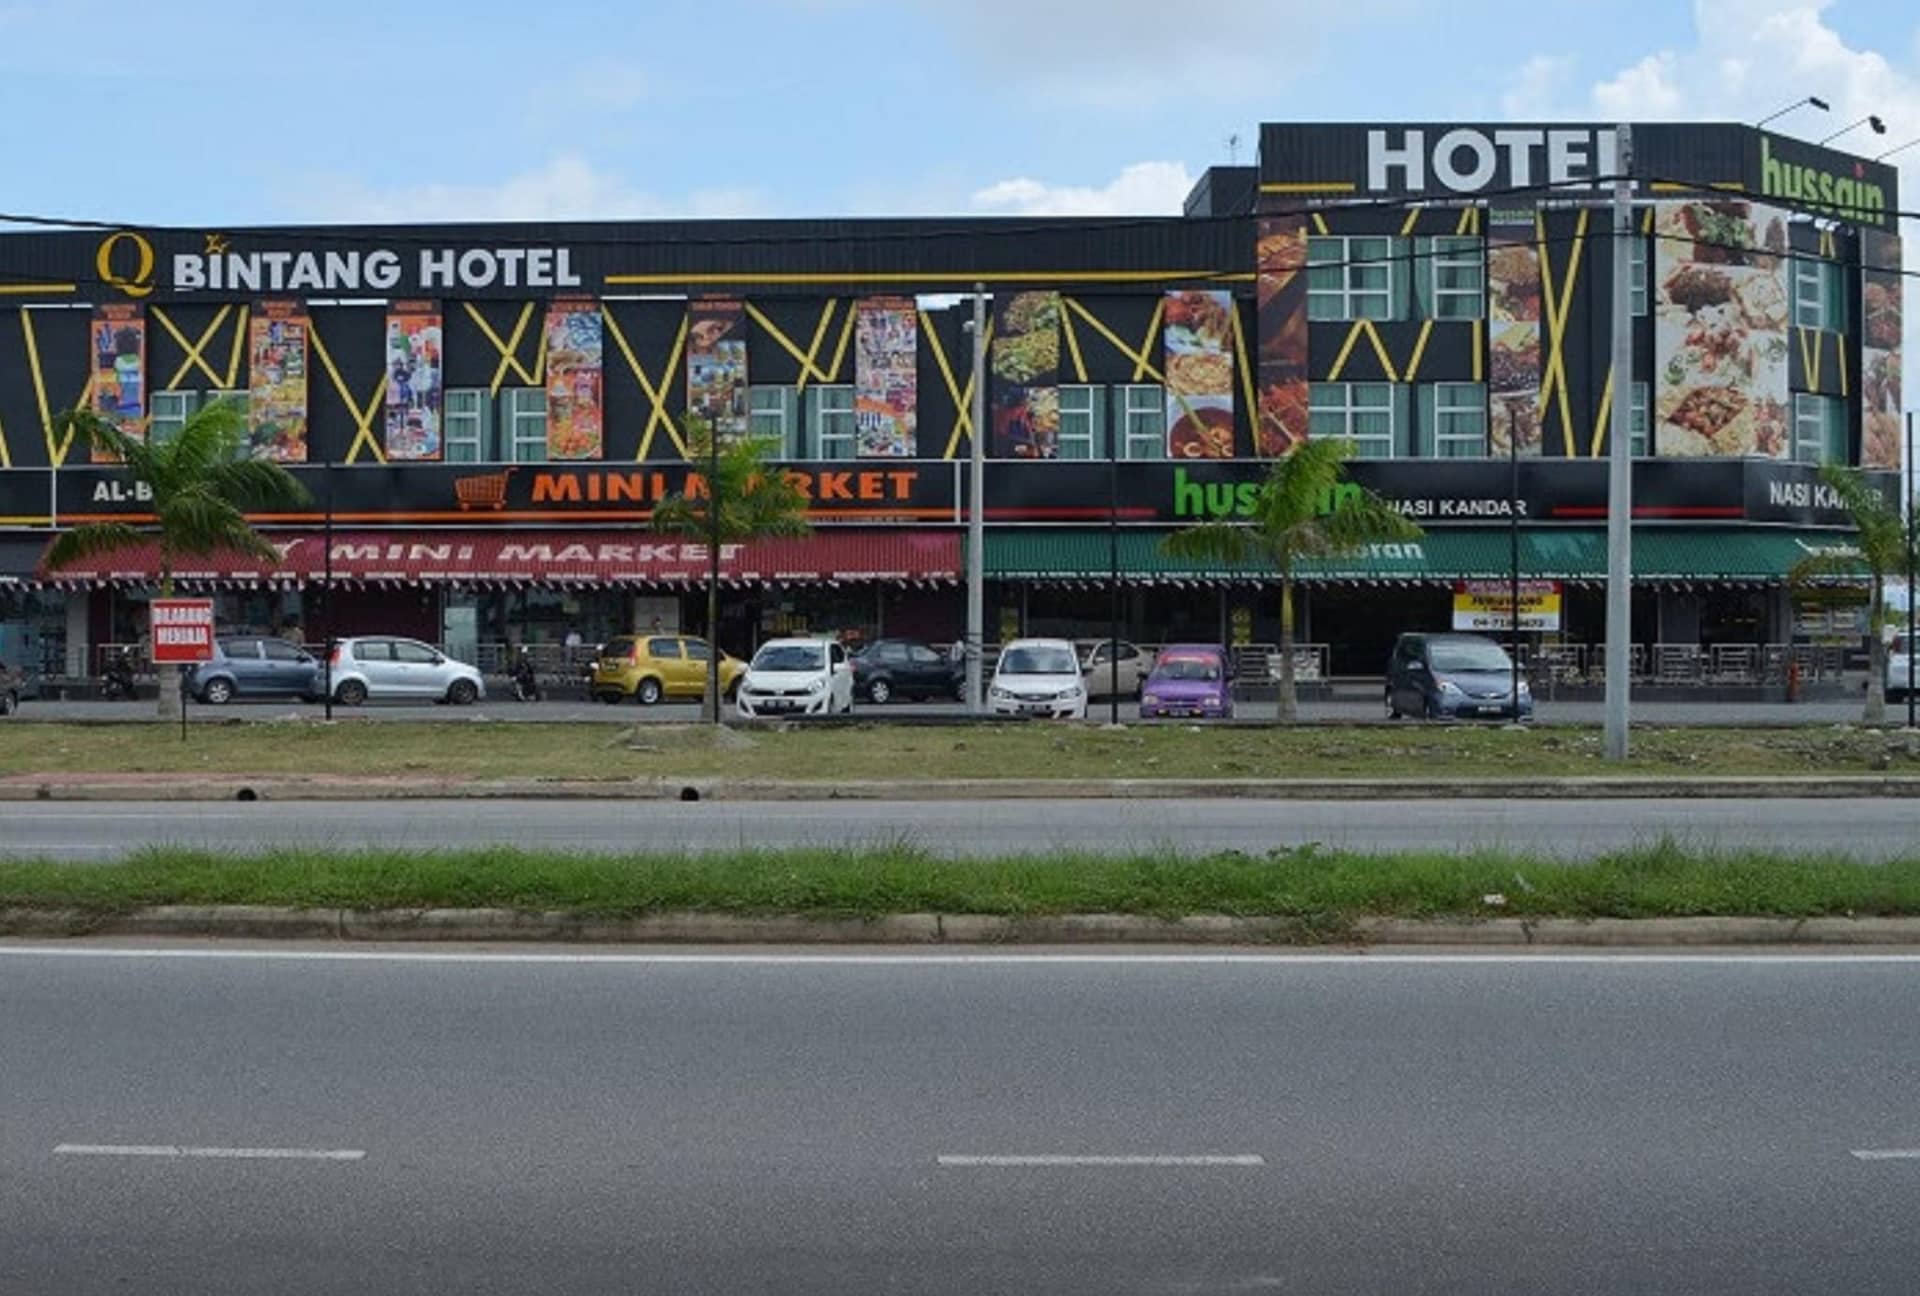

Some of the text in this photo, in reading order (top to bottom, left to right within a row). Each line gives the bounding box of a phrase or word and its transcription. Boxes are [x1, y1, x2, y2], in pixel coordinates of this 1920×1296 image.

[1368, 128, 1638, 192] HOTEL
[1761, 136, 1885, 225] hussain
[173, 251, 401, 291] BINTANG
[420, 249, 581, 287] HOTEL
[532, 472, 665, 501] MINI
[1174, 466, 1363, 516] husin
[1770, 480, 1810, 507] NASI
[1440, 499, 1528, 516] KANDAR
[330, 543, 745, 562] MINI MARKET
